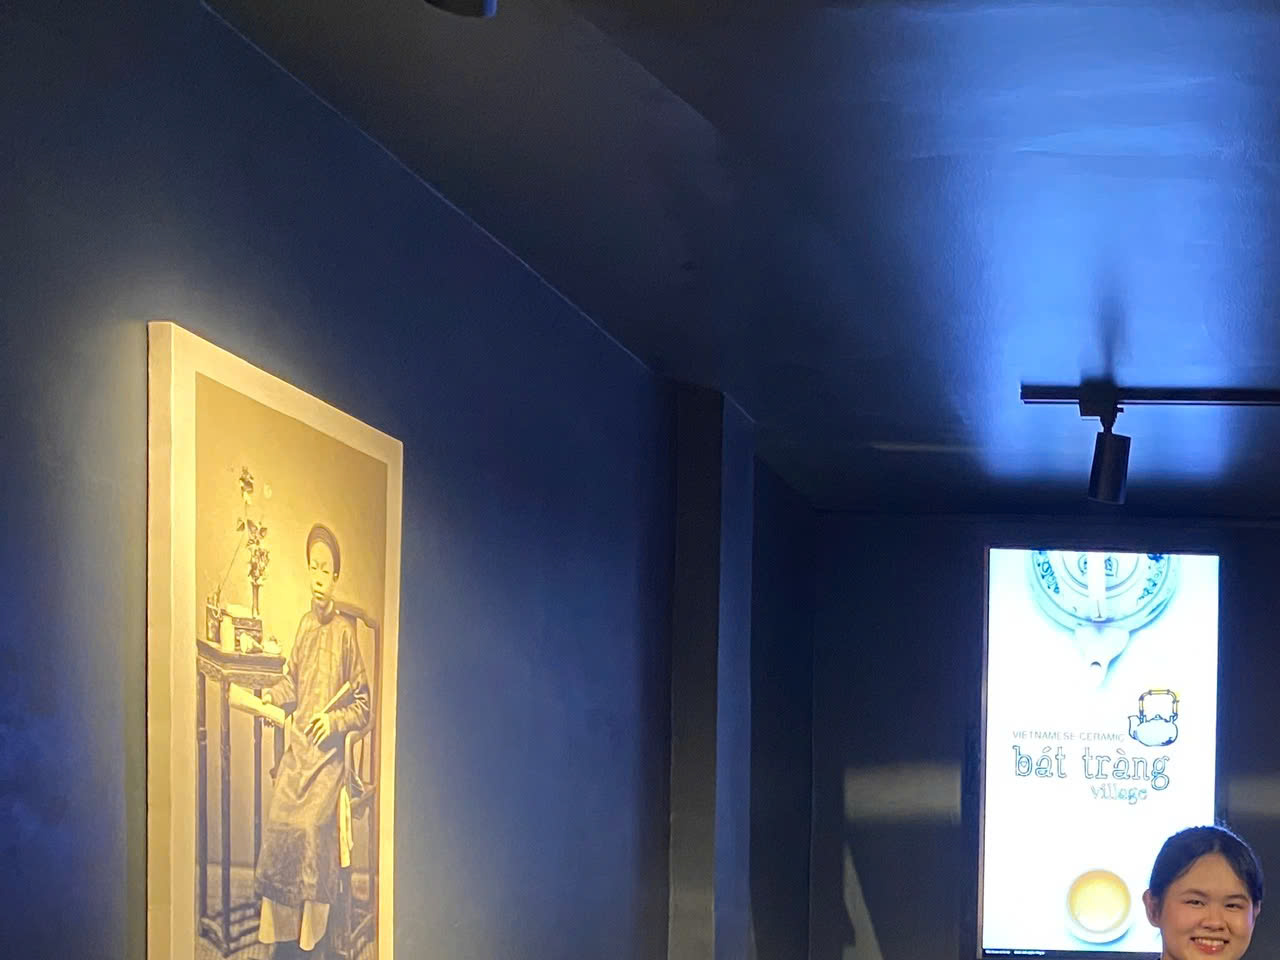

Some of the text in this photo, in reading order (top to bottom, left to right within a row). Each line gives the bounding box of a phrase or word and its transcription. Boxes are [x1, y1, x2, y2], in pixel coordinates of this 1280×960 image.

[1012, 730, 1125, 742] VIETNAMESE CERAMIC
[1012, 745, 1170, 790] bát tràng
[1090, 783, 1148, 805] village
